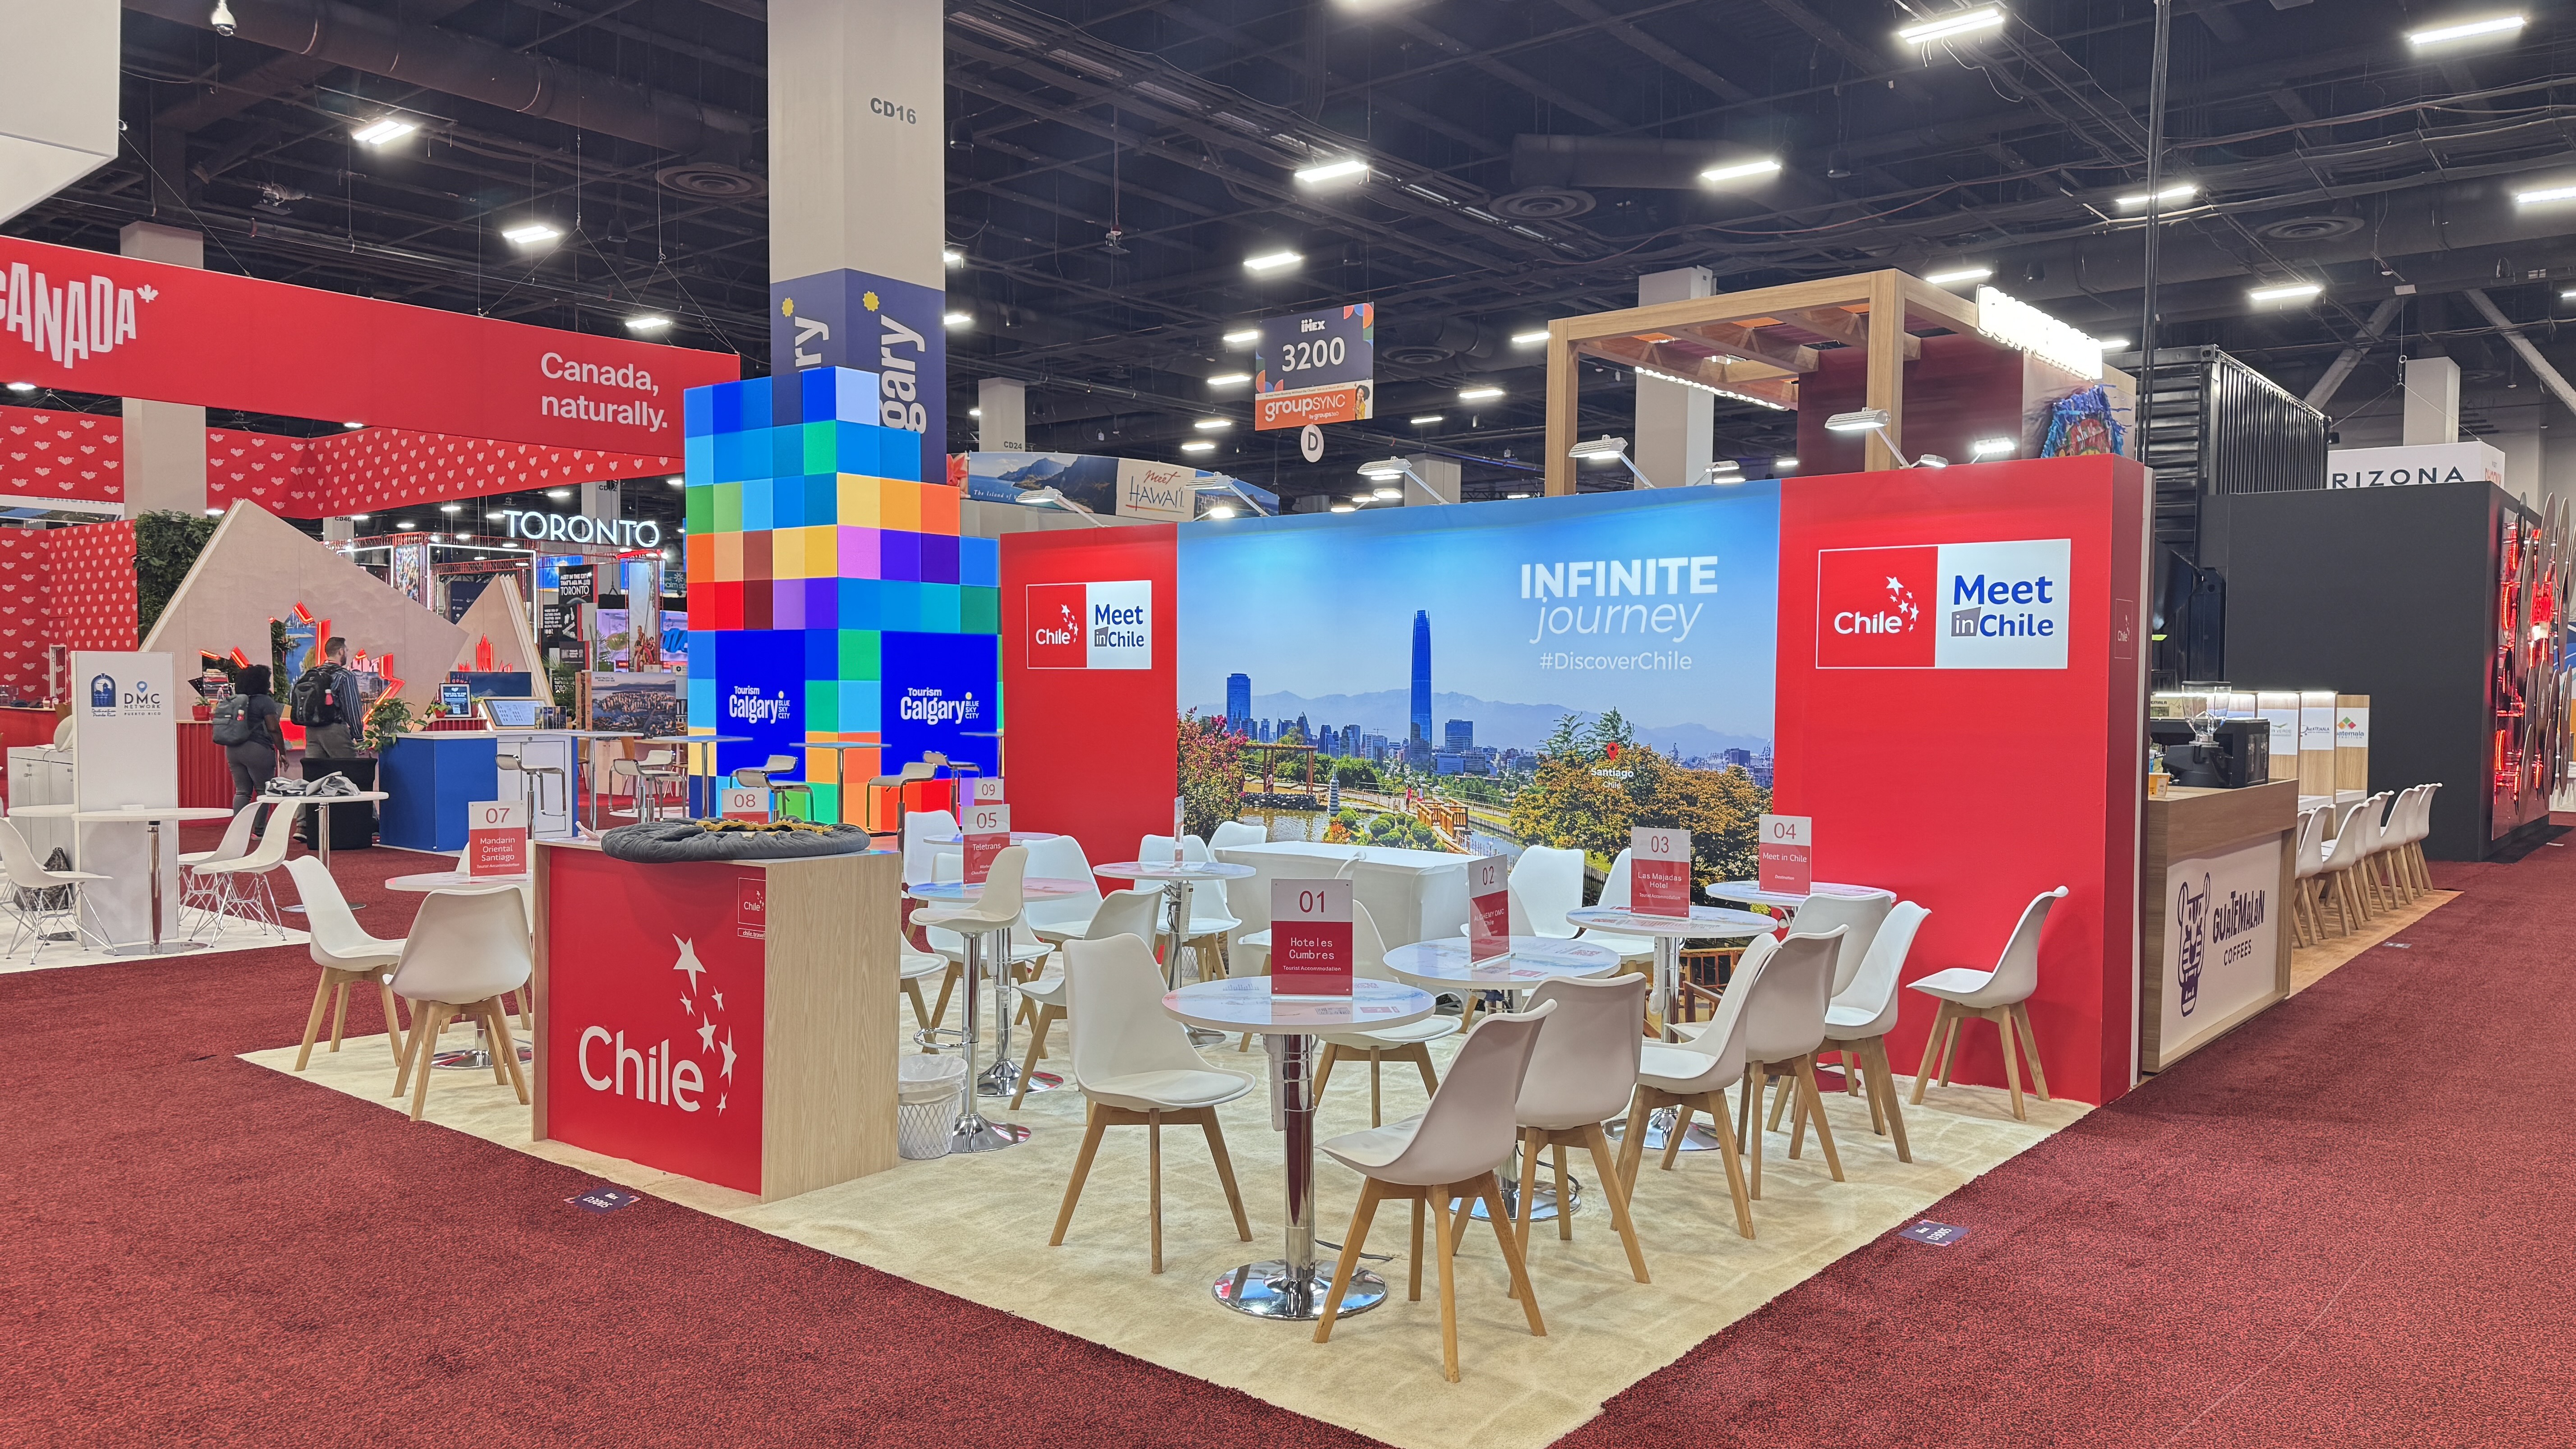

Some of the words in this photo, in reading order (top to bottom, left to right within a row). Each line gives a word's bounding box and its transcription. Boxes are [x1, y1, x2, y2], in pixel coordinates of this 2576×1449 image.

[870, 98, 916, 124] CD16
[1282, 337, 1345, 372] 3200
[541, 352, 658, 397] Canada,
[542, 396, 668, 432] naturally.
[1004, 441, 1022, 450] CD24
[1308, 432, 1318, 451] D
[1145, 470, 1181, 485] Meet
[503, 510, 660, 547] TORONTO
[1522, 556, 1718, 598] INFINITE
[561, 585, 589, 596] TORONTO
[1954, 574, 2053, 605] Meet
[1095, 604, 1143, 625] Meet
[1529, 596, 1704, 644] journey
[1834, 610, 1902, 635] Chile
[1979, 613, 2053, 637] Chile
[1036, 628, 1071, 645] Chile
[1109, 631, 1144, 647] Chile
[1540, 651, 1692, 670] #DiscoverChile
[124, 693, 160, 704] DMC
[734, 685, 759, 695] Tourism
[907, 687, 942, 696] Tourism
[729, 695, 778, 724] Calgary
[901, 696, 965, 725] Calgary
[1591, 768, 1634, 780] Santiago
[982, 784, 995, 796] 09
[734, 794, 755, 807] 08
[486, 808, 510, 823] 07
[977, 812, 997, 828] 05
[1774, 823, 1796, 839] 04
[1651, 836, 1669, 853] 03
[1763, 852, 1780, 860] Meet
[1482, 866, 1494, 885] 02
[1652, 873, 1682, 882] Majadas
[744, 902, 760, 911] Chile
[1299, 891, 1325, 913] 01
[1291, 937, 1333, 947] Hoteles
[1289, 949, 1334, 959] Cumbres
[2224, 939, 2251, 966] COFFEES
[579, 1026, 704, 1112] Chile
[583, 1196, 613, 1208] D3005
[1927, 1228, 1952, 1241] D3005
